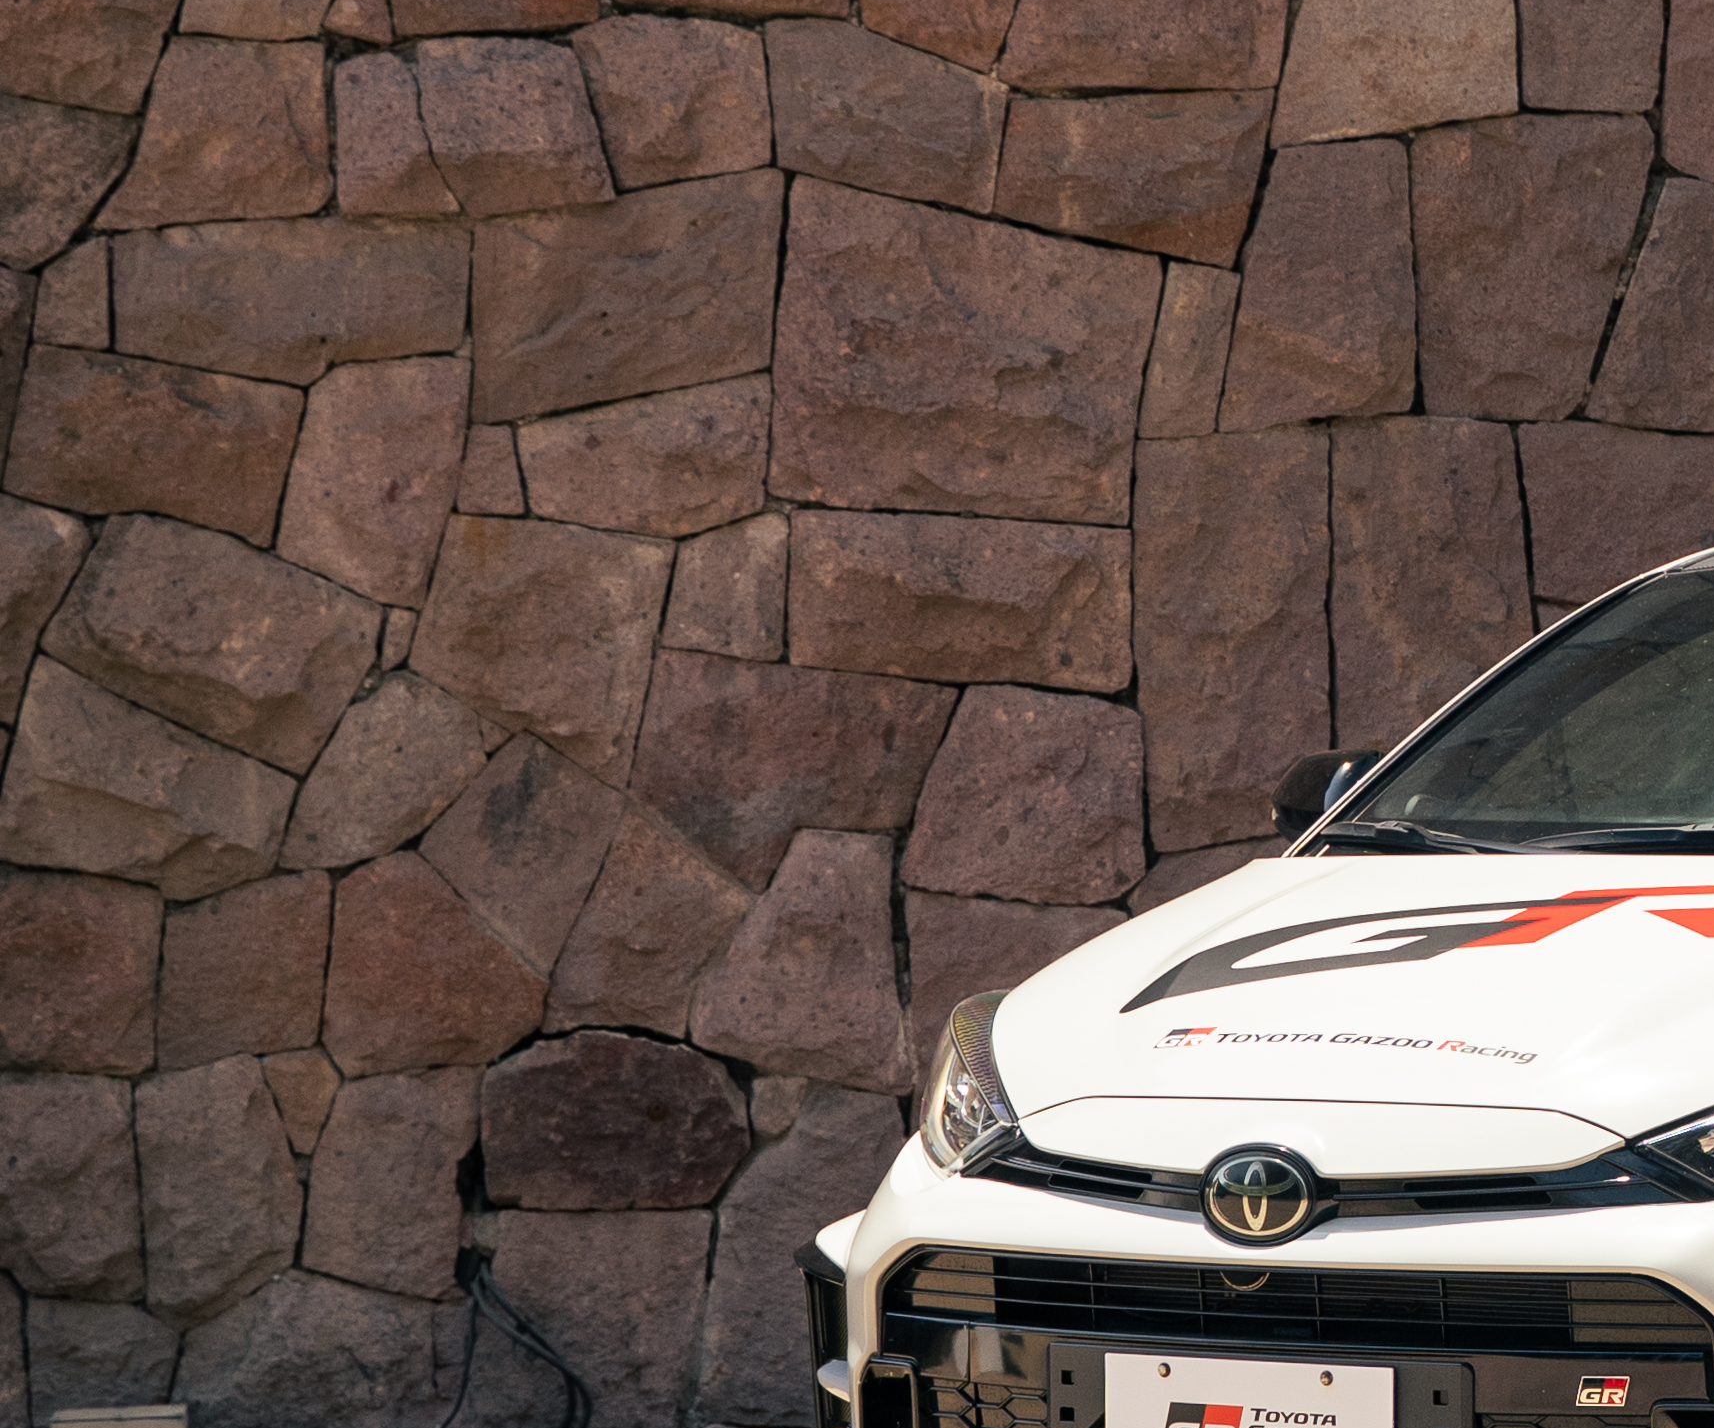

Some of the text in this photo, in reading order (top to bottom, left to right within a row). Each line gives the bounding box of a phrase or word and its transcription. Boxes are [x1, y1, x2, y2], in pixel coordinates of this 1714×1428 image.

[1154, 1032, 1538, 1065] GR TOYOTA GAZOO Racing
[1580, 1388, 1624, 1404] GR
[1250, 1407, 1337, 1427] TOYOTA
